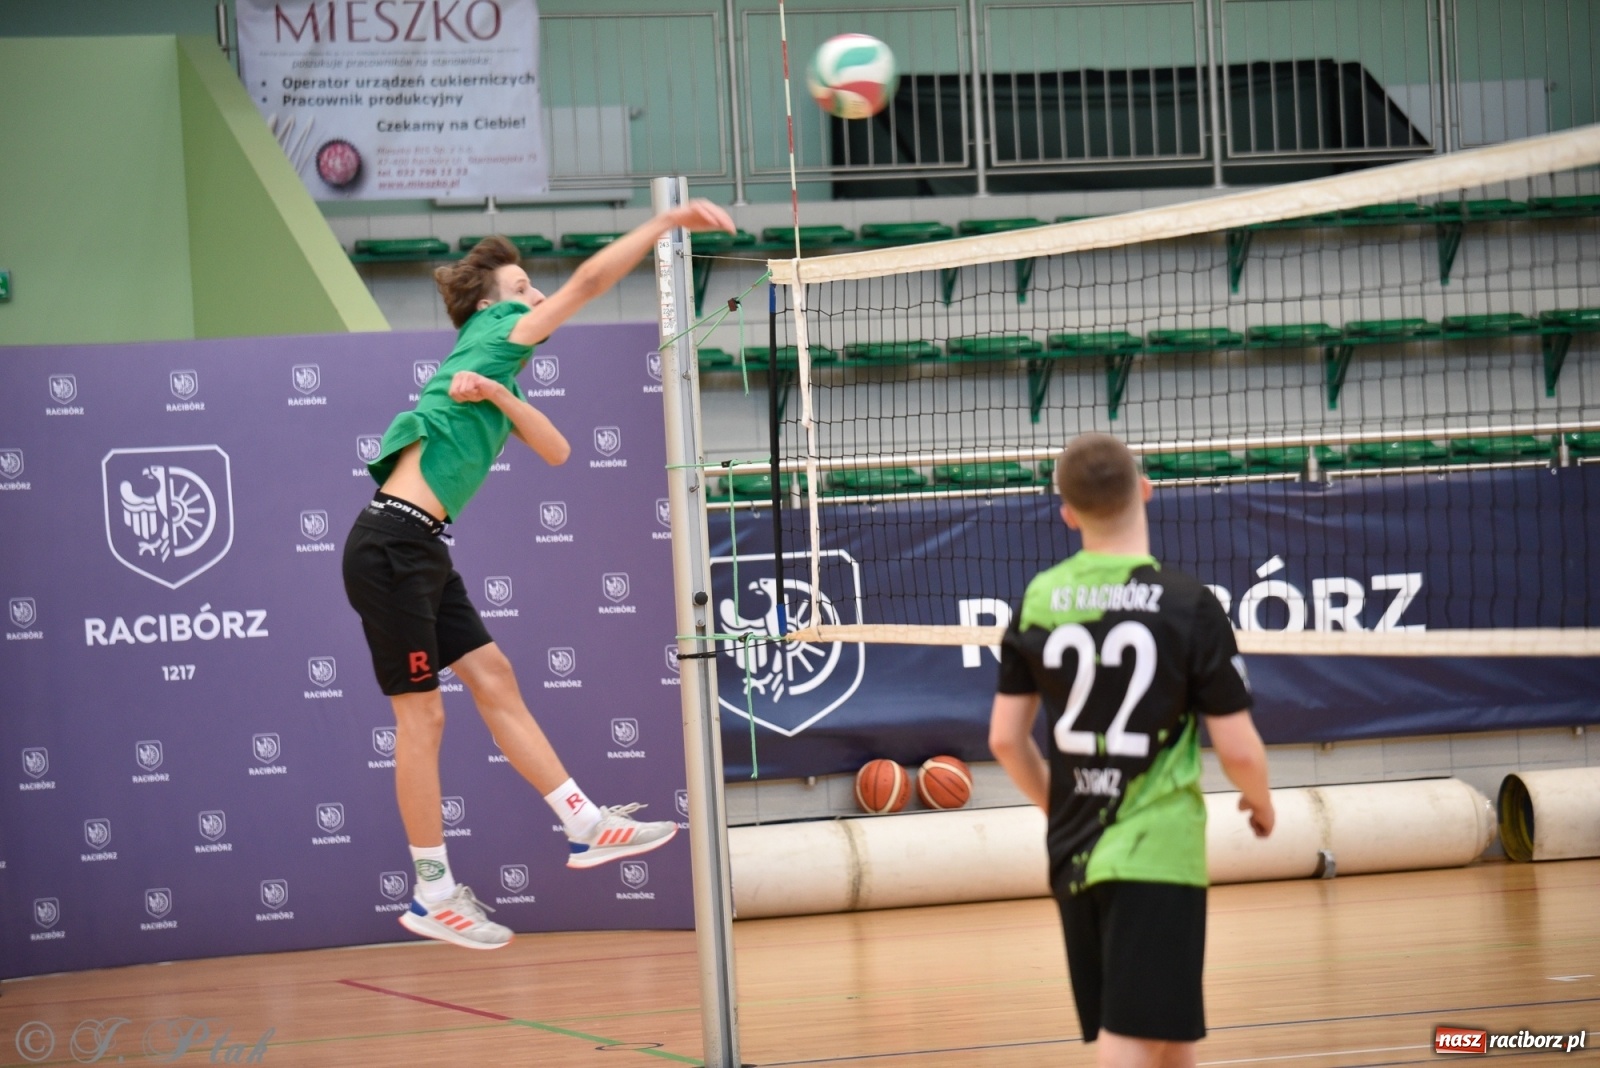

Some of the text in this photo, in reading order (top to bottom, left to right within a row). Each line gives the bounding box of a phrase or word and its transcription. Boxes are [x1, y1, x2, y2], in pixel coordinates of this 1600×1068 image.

[275, 0, 502, 43] MIESZKO
[282, 71, 535, 91] Operator urządzeń cukierniczych
[282, 93, 464, 108] Pracownik produkcyjny
[377, 115, 526, 134] Czekamy na Ciebie!
[528, 388, 566, 397] RACIBÓRZ
[288, 397, 327, 406] RACIBÓRZ
[46, 406, 84, 415] RACIBÓRZ
[166, 402, 205, 411] RACIBÓRZ
[590, 459, 627, 468] RACIBÓRZ
[0, 481, 31, 490] ACIBÓRZ
[536, 534, 574, 543] RACIBÓRZ
[296, 543, 335, 552] RACIBÓRZ
[1051, 578, 1164, 612] KS RACIBÓRZ
[480, 608, 519, 617] RACIBÓRZ
[598, 604, 636, 613] RACIBÓRZ
[85, 602, 269, 646] RACIBÓRZ
[6, 631, 43, 640] RACIBÓRZ
[162, 664, 196, 681] 1217
[544, 679, 582, 688] RACIBÓRZ
[304, 689, 343, 698] RACIBÓRZ
[1043, 620, 1158, 758] 22
[607, 749, 645, 758] RACIBÓRZ
[368, 759, 397, 768] RACIBÓ
[249, 766, 287, 775] RACIBÓRZ
[132, 774, 170, 783] RACIBÓRZ
[19, 781, 56, 790] RACIBÓRZ
[443, 828, 471, 837] CIBÓRZ
[312, 835, 351, 844] RACIBÓRZ
[195, 844, 232, 853] RACIBÓRZ
[81, 852, 117, 861] RACIBÓRZ
[616, 890, 655, 899] RACIBÓRZ
[496, 895, 535, 904] RACIBÓRZ
[256, 912, 294, 921] RACIBÓRZ
[140, 921, 178, 930] RACIBÓRZ
[30, 931, 65, 940] RACIBÓRZ
